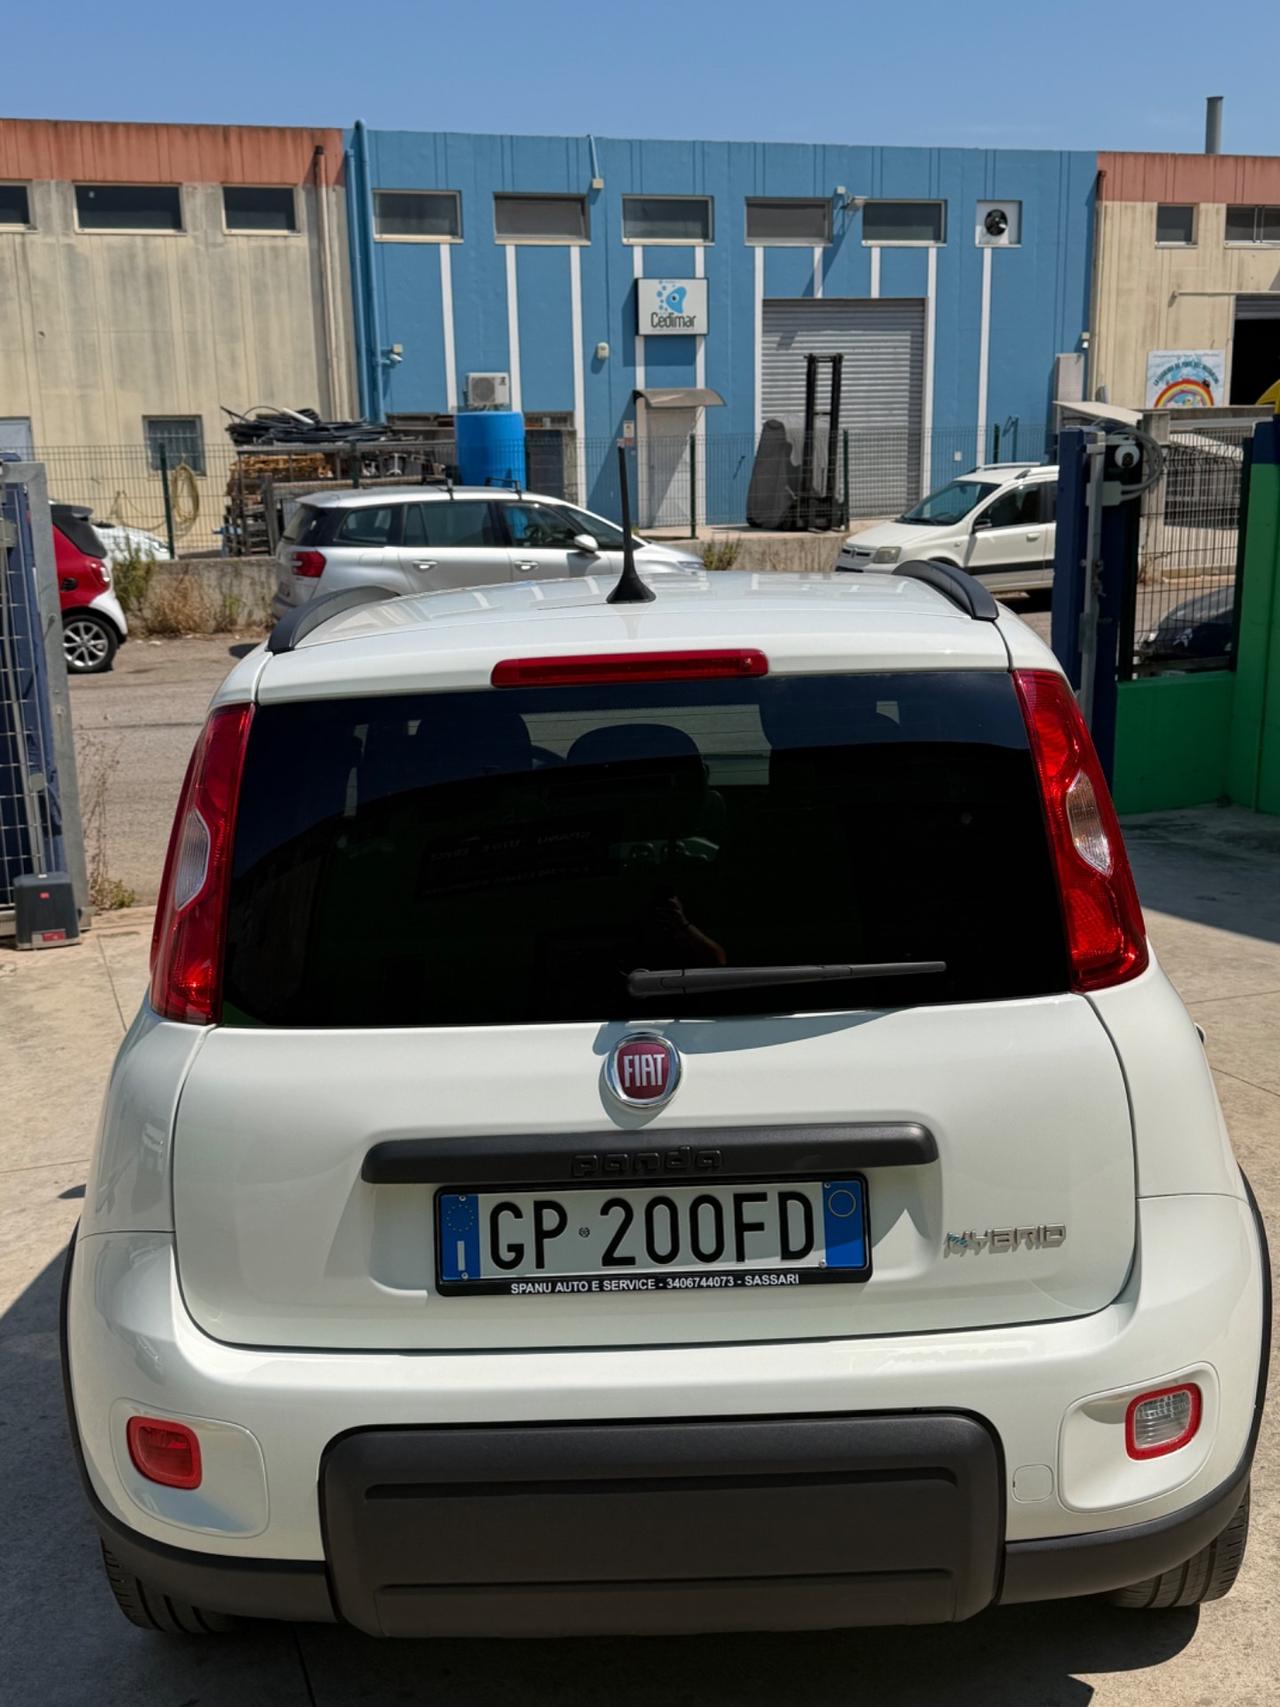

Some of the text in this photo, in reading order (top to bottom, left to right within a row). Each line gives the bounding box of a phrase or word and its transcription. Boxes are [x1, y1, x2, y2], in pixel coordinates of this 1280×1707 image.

[650, 312, 696, 328] Cedimar
[623, 1053, 666, 1088] FIAT
[488, 1199, 568, 1271] GP
[599, 1190, 815, 1268] 200FD
[945, 1222, 1067, 1258] HYBRID
[510, 1282, 553, 1294] SPANU
[556, 1280, 589, 1293] AUTO
[591, 1280, 600, 1292] E
[603, 1278, 656, 1291] SERVICE
[666, 1275, 735, 1289] 3406744073
[744, 1273, 799, 1287] SASSARI
